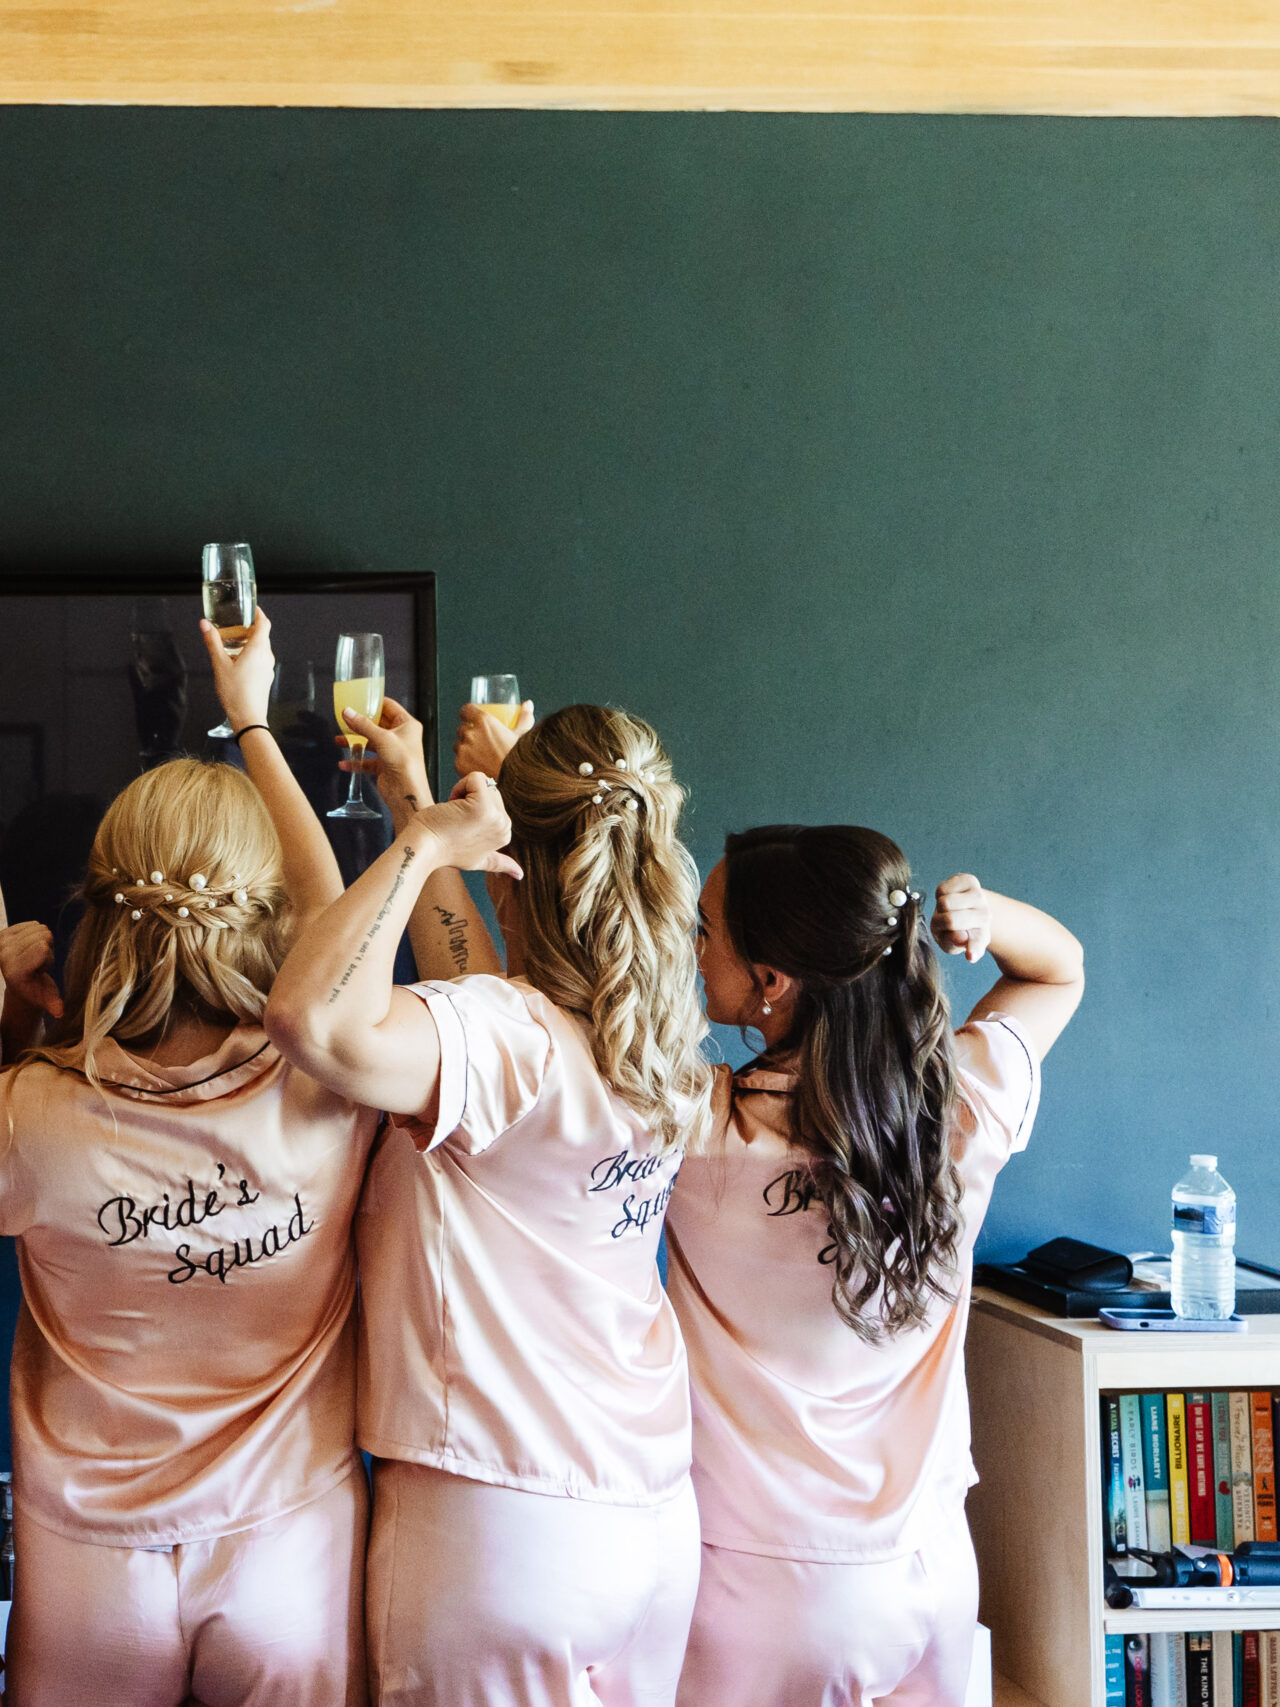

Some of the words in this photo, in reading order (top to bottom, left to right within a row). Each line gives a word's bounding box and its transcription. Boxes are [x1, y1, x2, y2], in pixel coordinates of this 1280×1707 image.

[340, 964, 357, 986] break
[97, 1163, 260, 1247] Bride's
[1150, 1406, 1159, 1431] LIANE
[1194, 1406, 1203, 1415] DO
[1111, 1431, 1120, 1458] SECRET
[1172, 1414, 1182, 1470] BILLIONAIRE
[1195, 1430, 1204, 1441] SAY
[1196, 1443, 1205, 1452] WE
[1129, 1443, 1137, 1471] BIRDS
[1151, 1434, 1161, 1480] MORIARTY
[1243, 1488, 1251, 1530] VERONICA
[1200, 1657, 1208, 1674] THE
[1201, 1676, 1209, 1699] KIND
